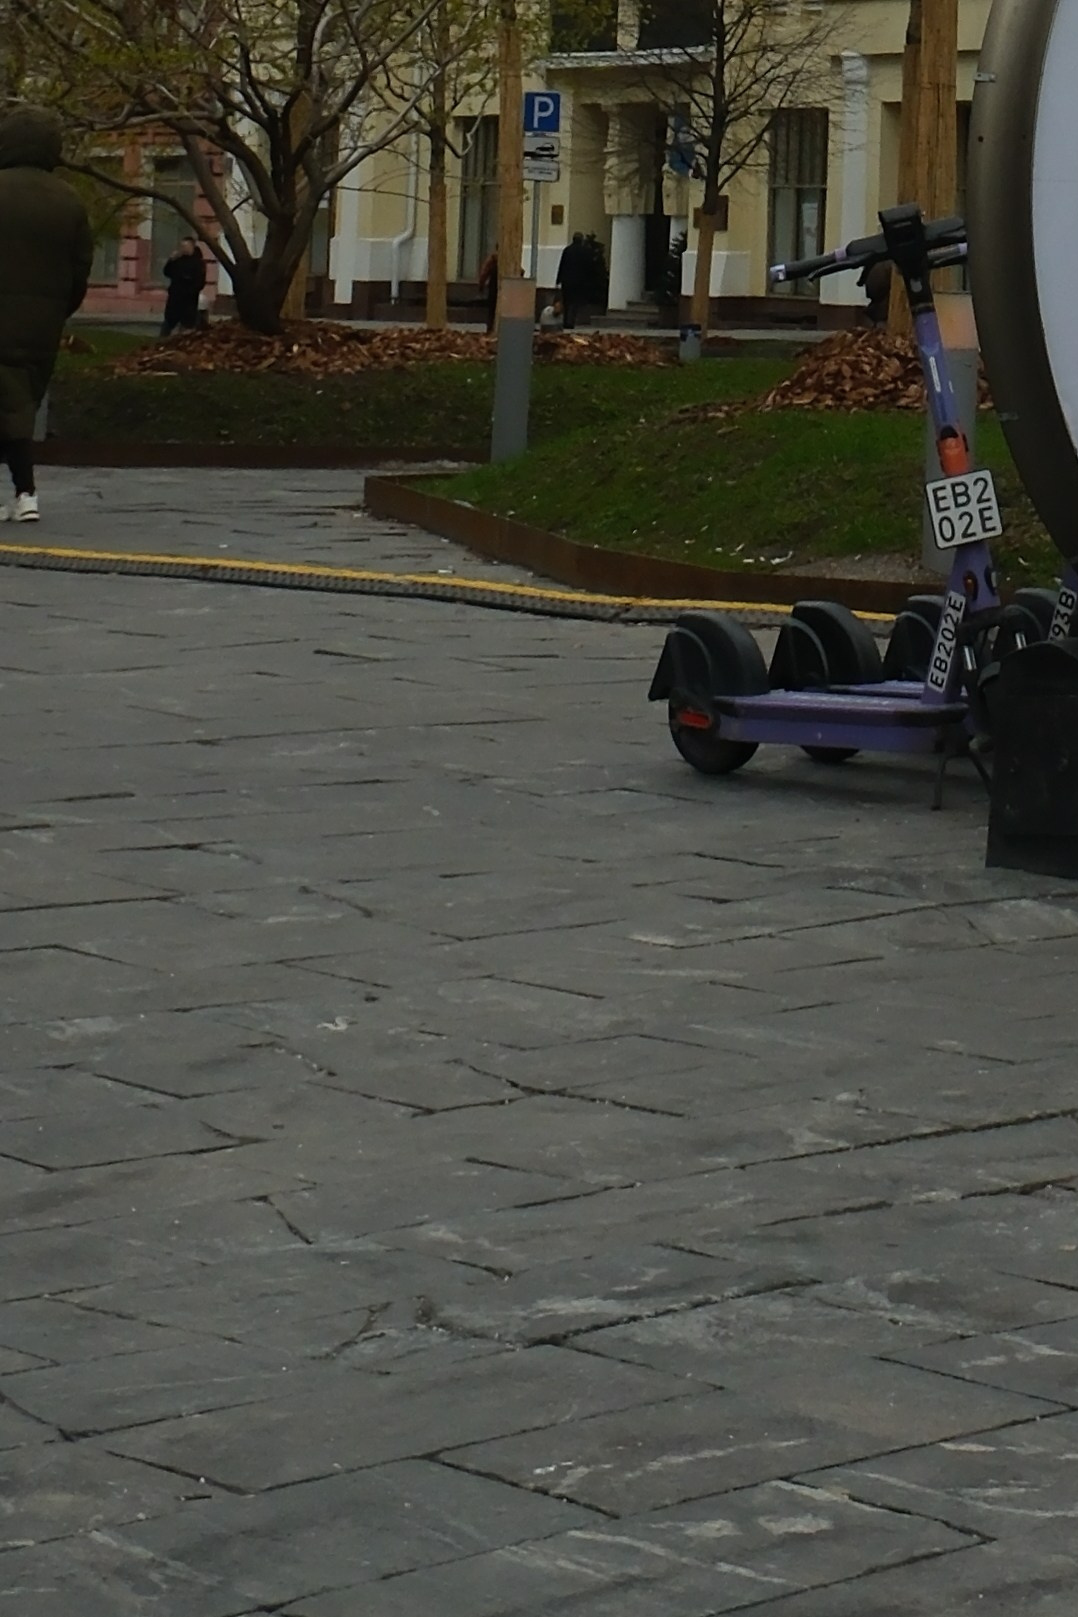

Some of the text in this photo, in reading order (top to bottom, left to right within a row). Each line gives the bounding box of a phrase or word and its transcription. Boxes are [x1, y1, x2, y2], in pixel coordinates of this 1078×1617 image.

[533, 96, 554, 129] P
[932, 477, 991, 513] EB2
[1050, 591, 1075, 640] 93B
[930, 595, 964, 688] EB202E
